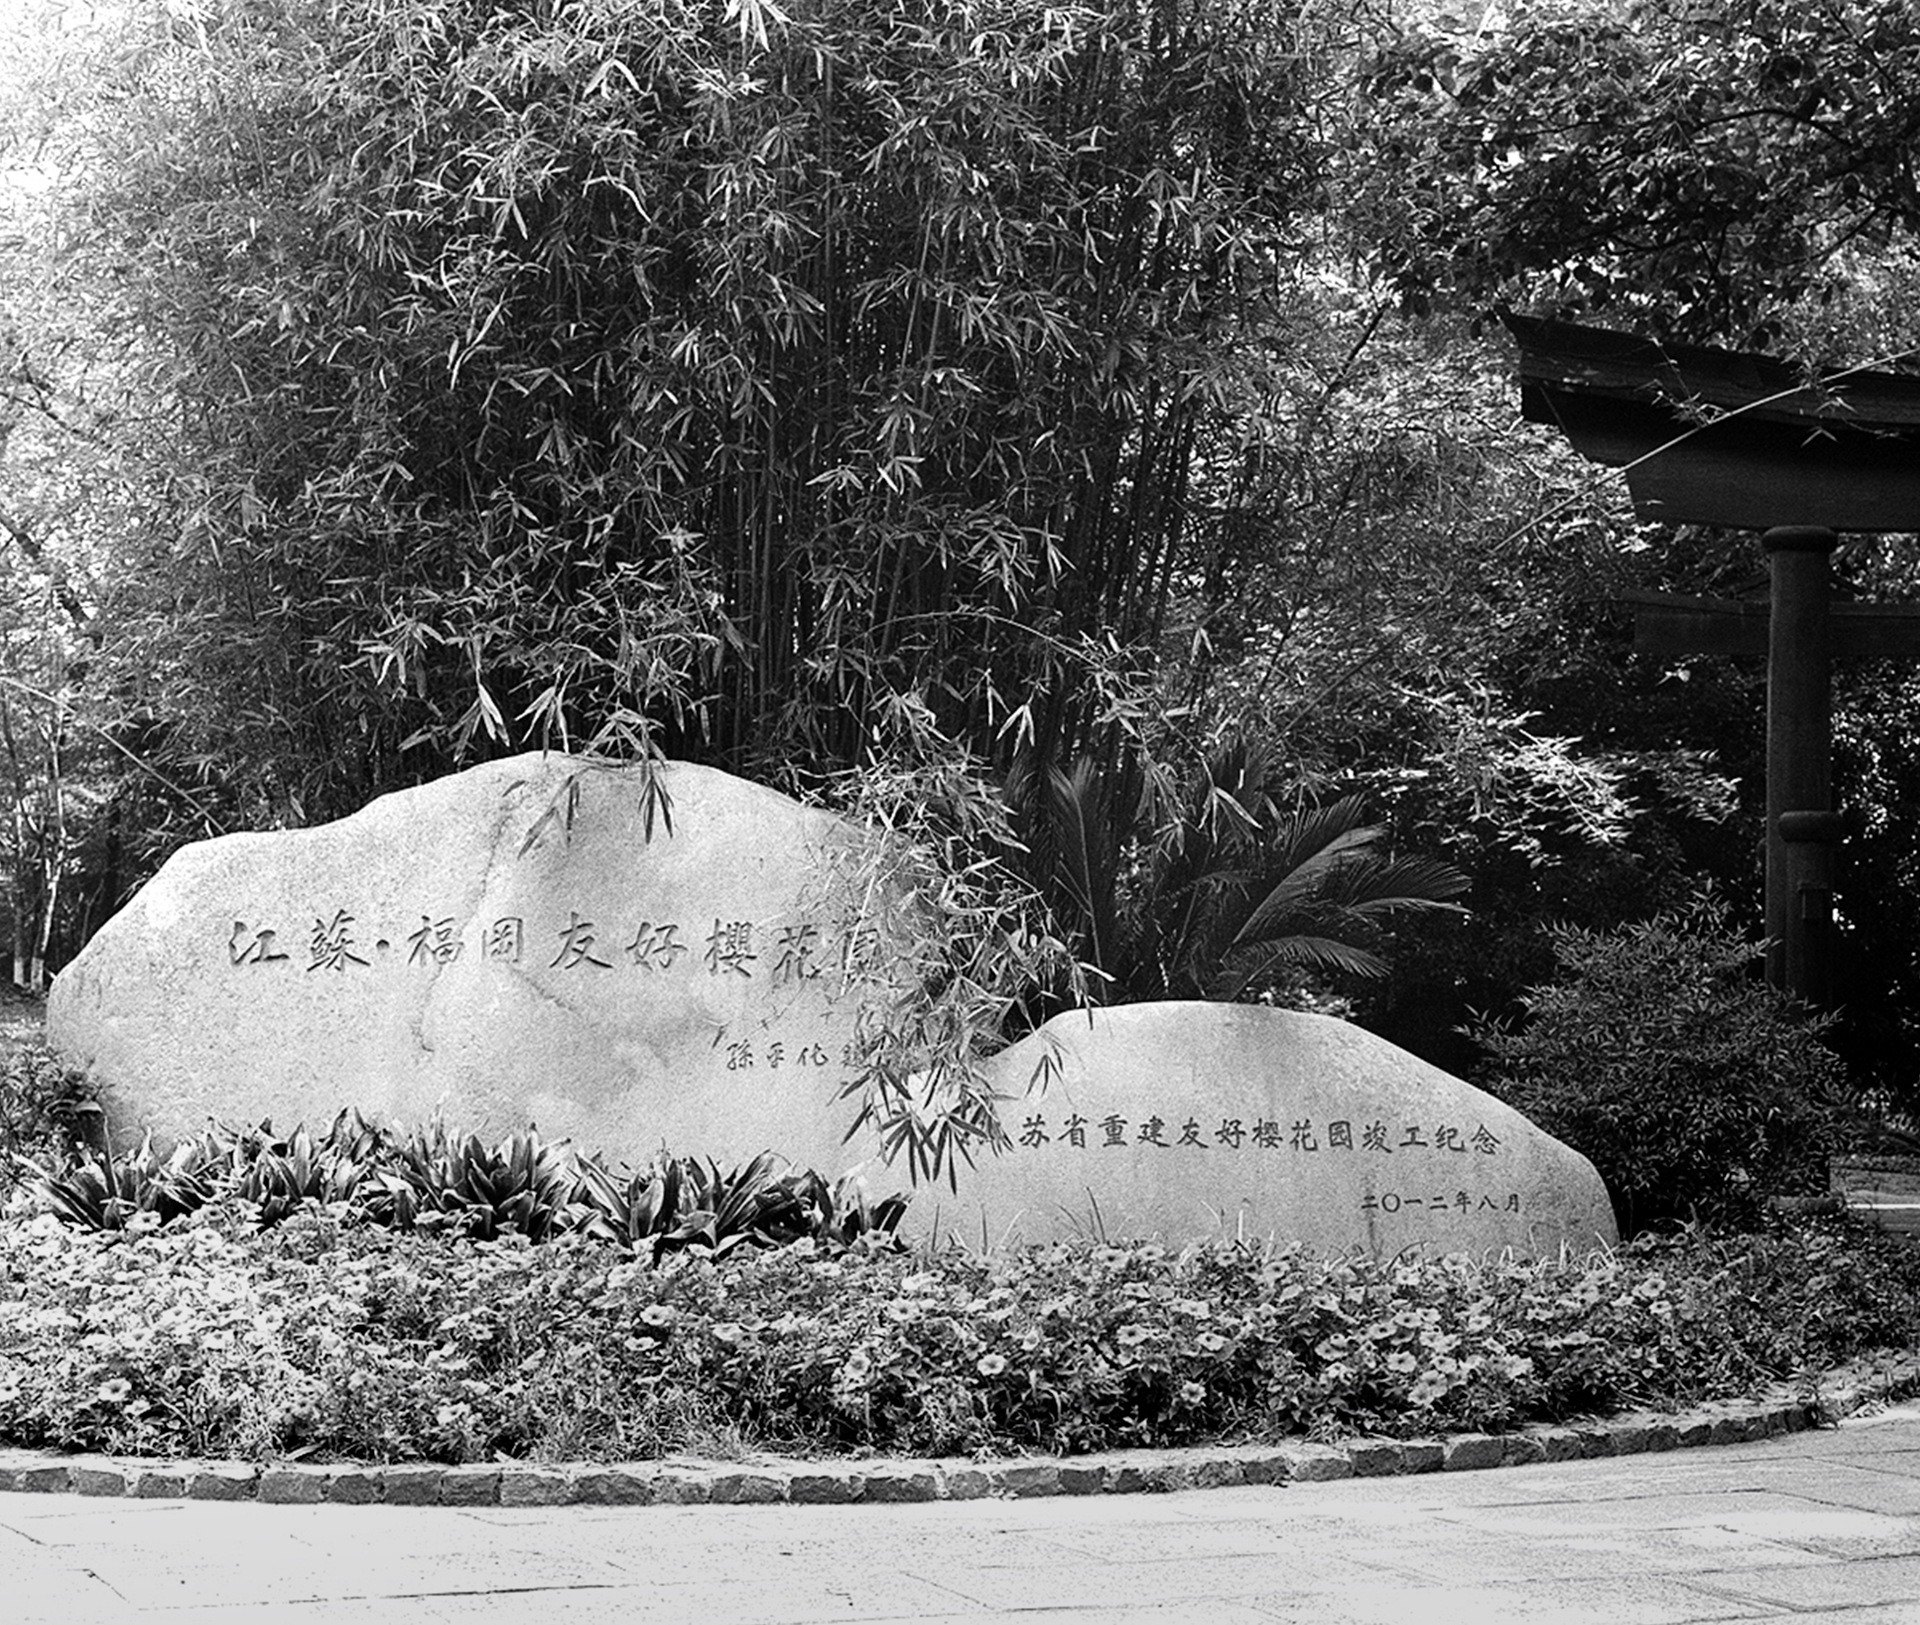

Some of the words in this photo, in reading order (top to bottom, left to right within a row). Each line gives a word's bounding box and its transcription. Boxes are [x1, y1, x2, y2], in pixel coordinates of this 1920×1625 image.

[978, 1113, 1502, 1156] 苏省重建友好樱花园竣工纪念
[1360, 1190, 1520, 1214] 二〇一二年八月
